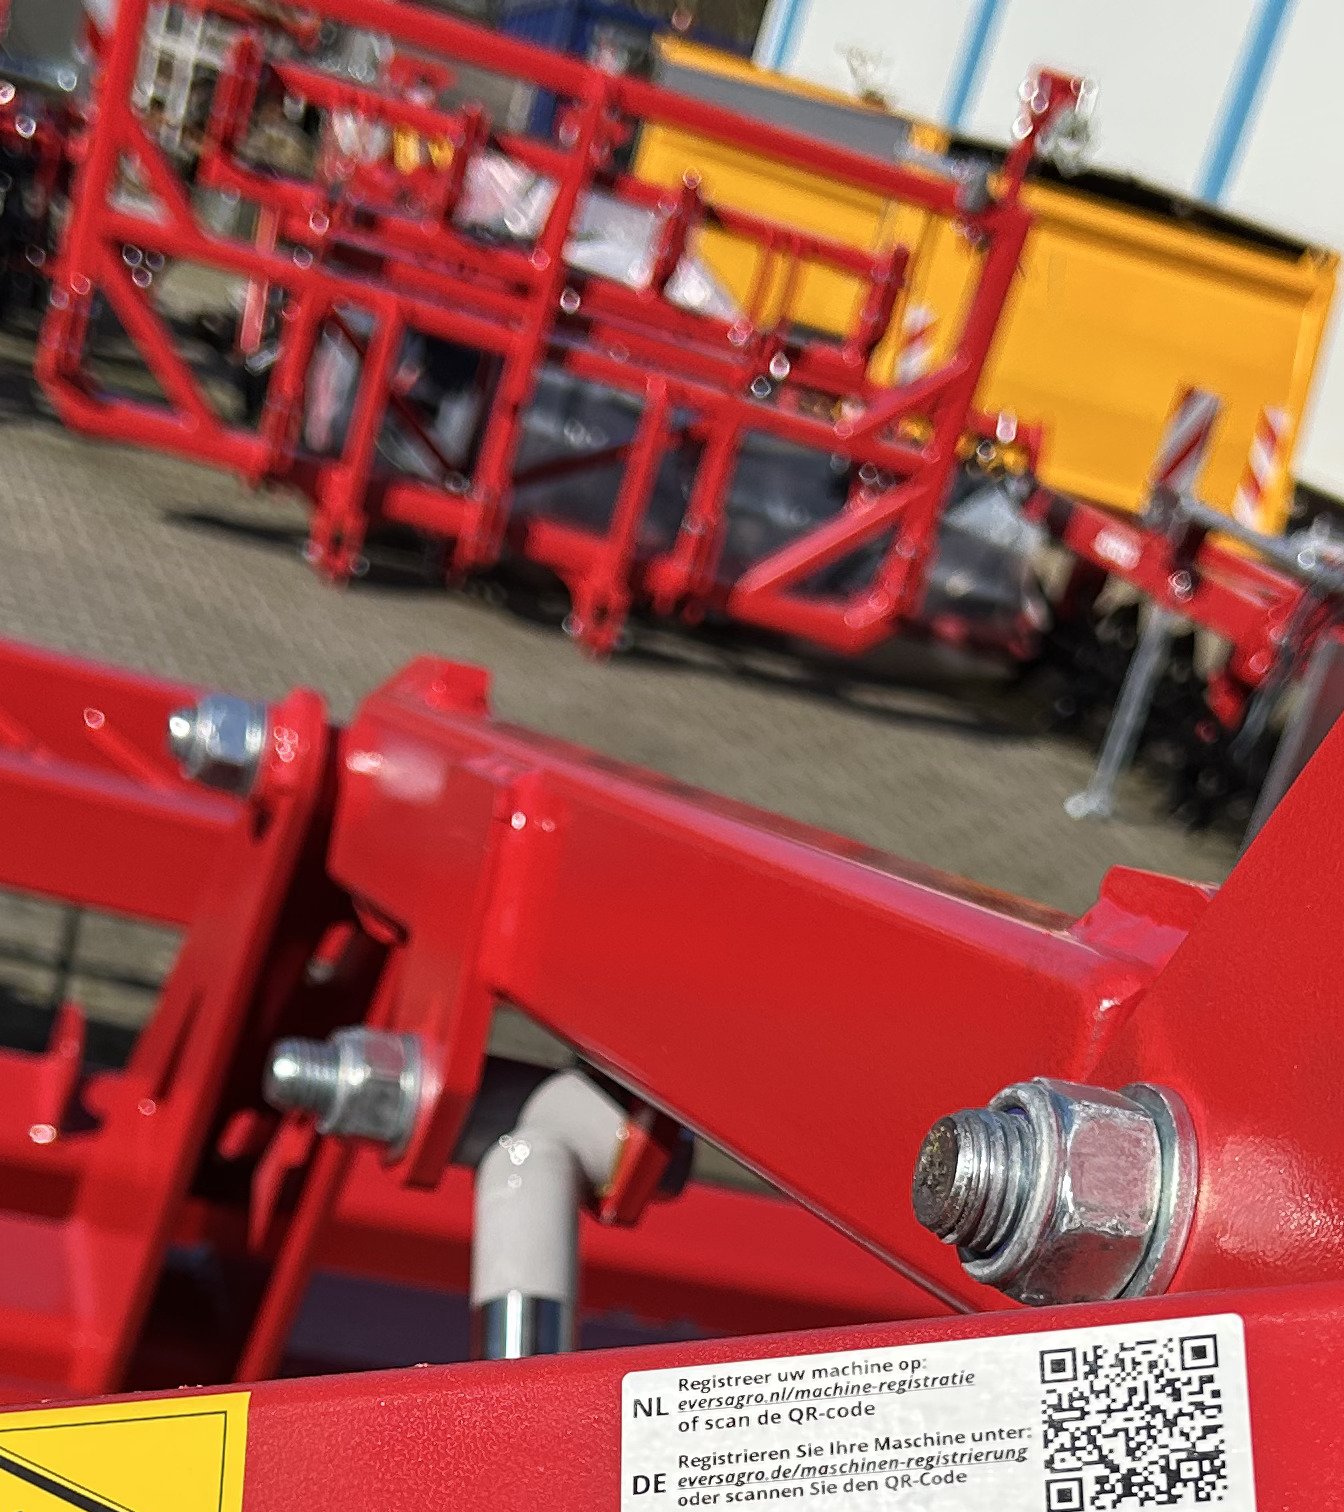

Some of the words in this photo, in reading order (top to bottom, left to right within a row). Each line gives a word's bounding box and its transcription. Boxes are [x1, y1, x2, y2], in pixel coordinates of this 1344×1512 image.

[676, 1370, 975, 1413] eversagro.nl/machine-registratie
[677, 1372, 772, 1394] Registreer
[776, 1368, 806, 1383] uw
[810, 1359, 894, 1379] machine
[897, 1357, 927, 1375] op:
[631, 1395, 670, 1419] NL
[676, 1414, 700, 1433] of
[703, 1414, 750, 1431] scan
[756, 1408, 782, 1426] de
[787, 1400, 876, 1425] QR-code
[677, 1447, 791, 1471] Registrieren
[794, 1442, 824, 1459] Sie
[828, 1439, 869, 1456] Ihre
[873, 1430, 966, 1451] Maschine
[969, 1426, 1033, 1443] unter:
[631, 1471, 667, 1496] DE
[676, 1447, 1029, 1490] eversagro.de/maschinen-registrierung
[676, 1490, 721, 1507] oder
[724, 1485, 804, 1503] scannen
[808, 1479, 838, 1496] Sie
[841, 1477, 879, 1493] den
[883, 1469, 968, 1491] QR-Code
